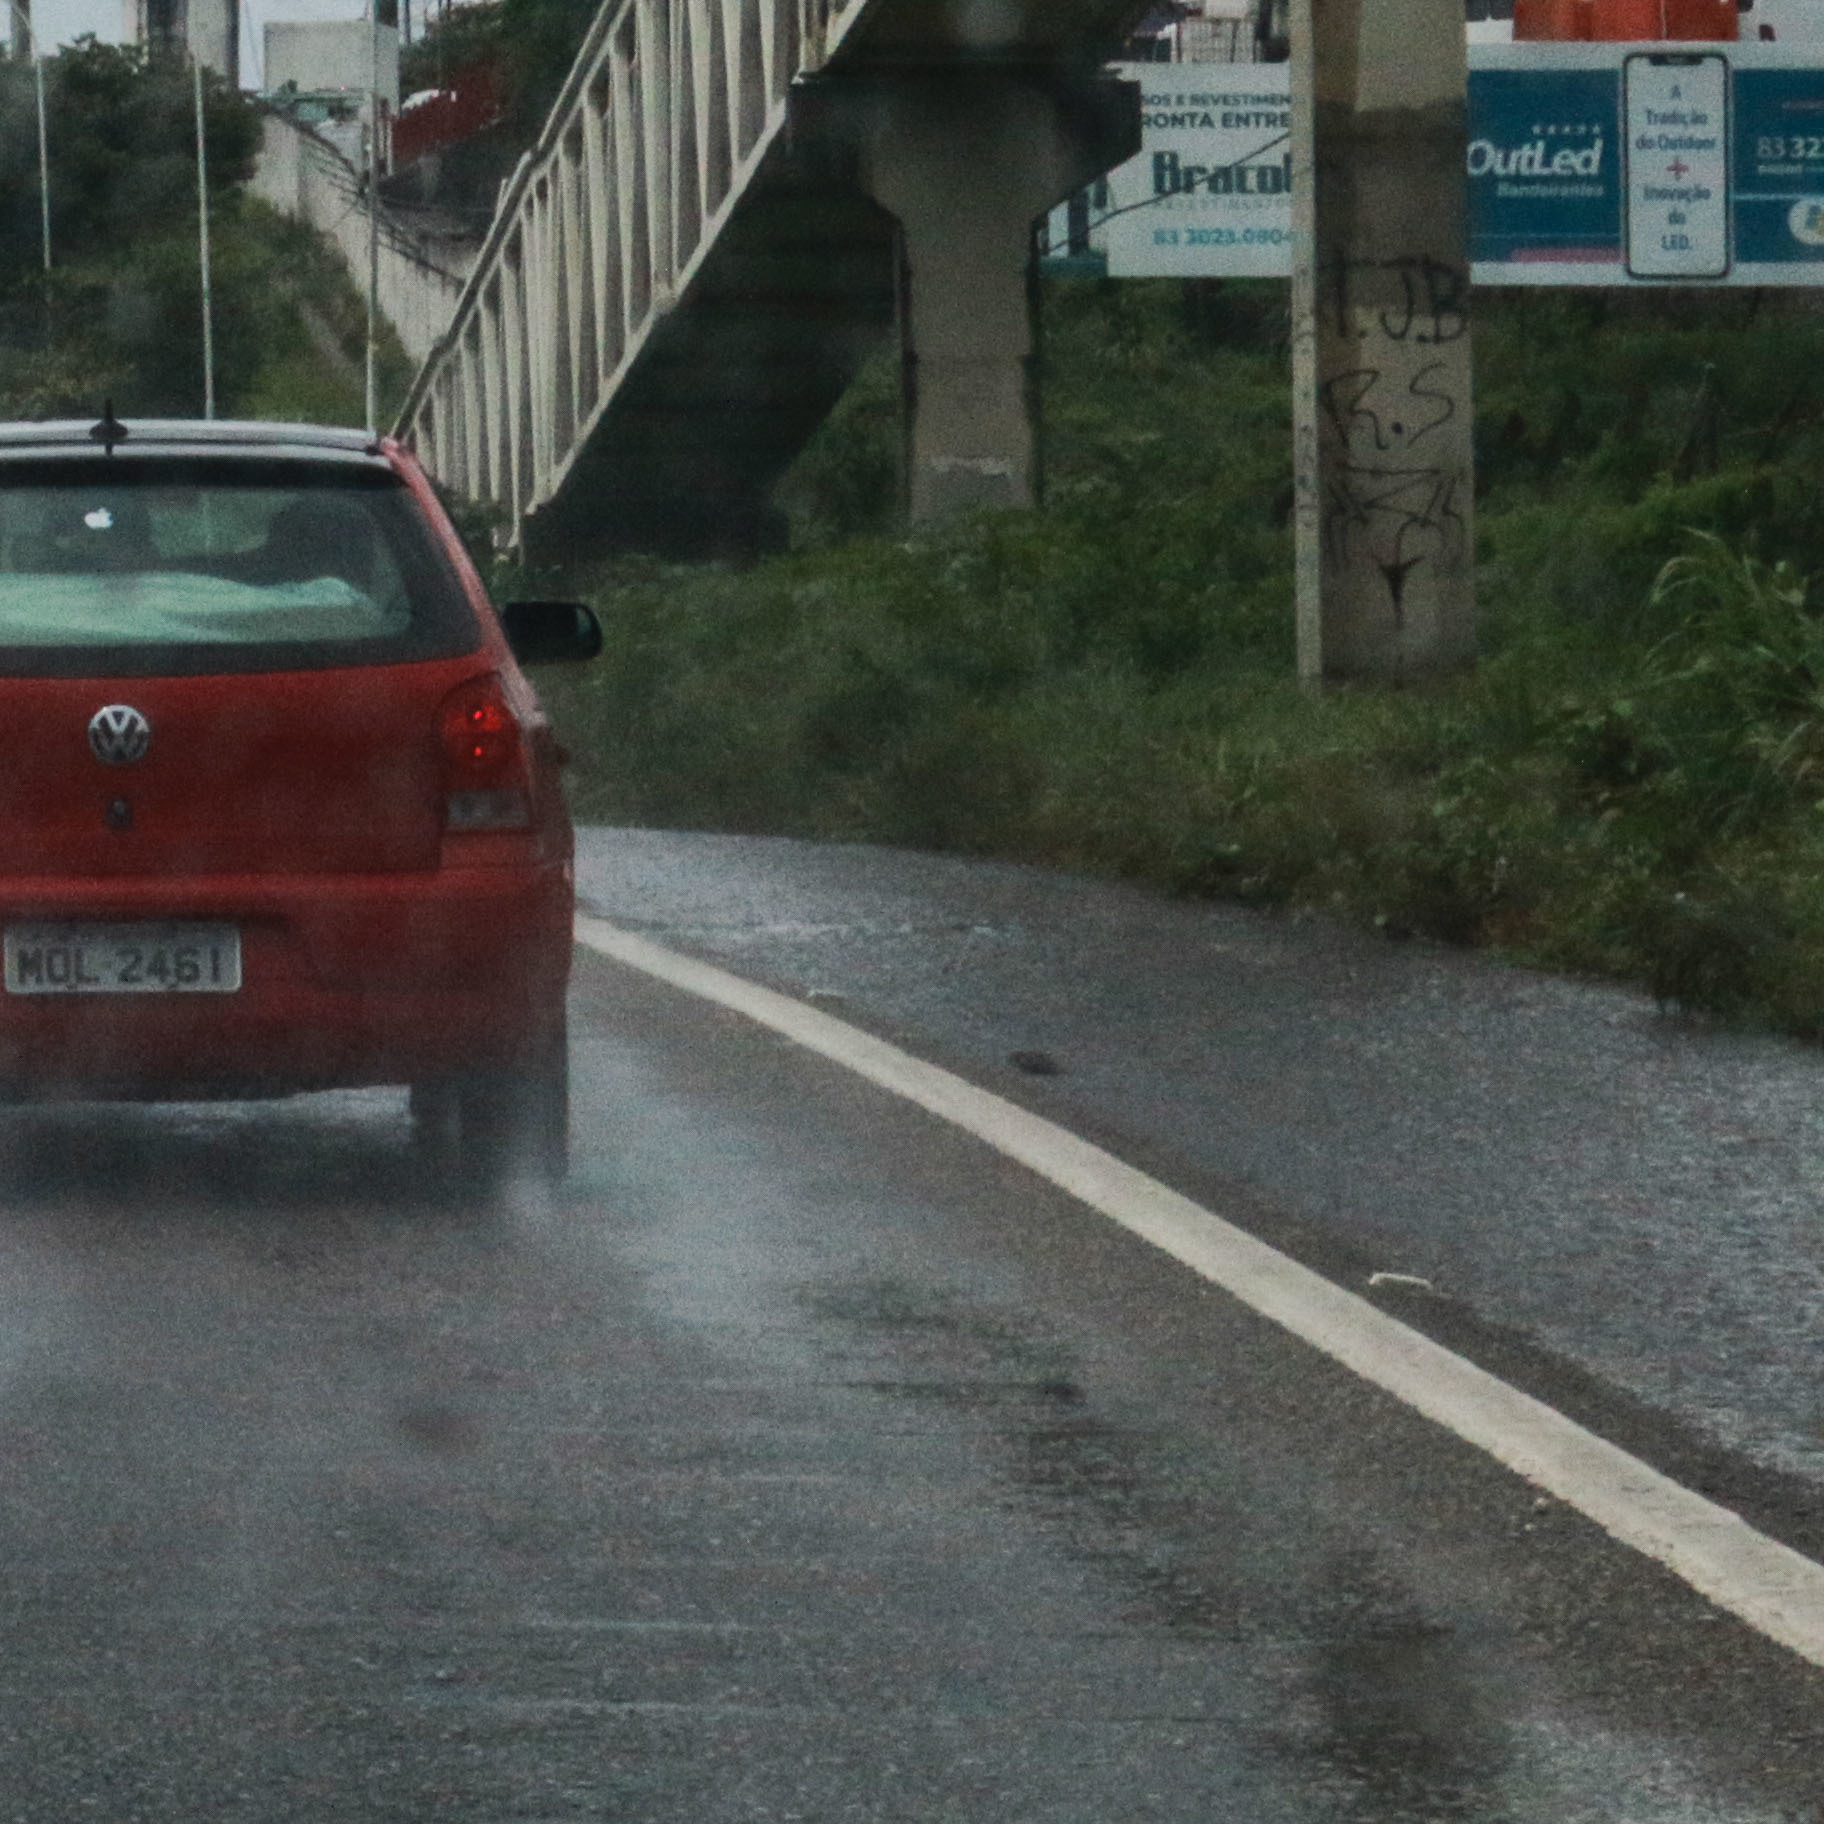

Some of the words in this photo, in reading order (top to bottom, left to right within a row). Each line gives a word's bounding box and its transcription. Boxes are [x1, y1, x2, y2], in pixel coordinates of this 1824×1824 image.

[1176, 94, 1185, 106] E
[1670, 84, 1682, 100] A
[1466, 137, 1604, 176] OutLed
[1788, 136, 1824, 159] 32
